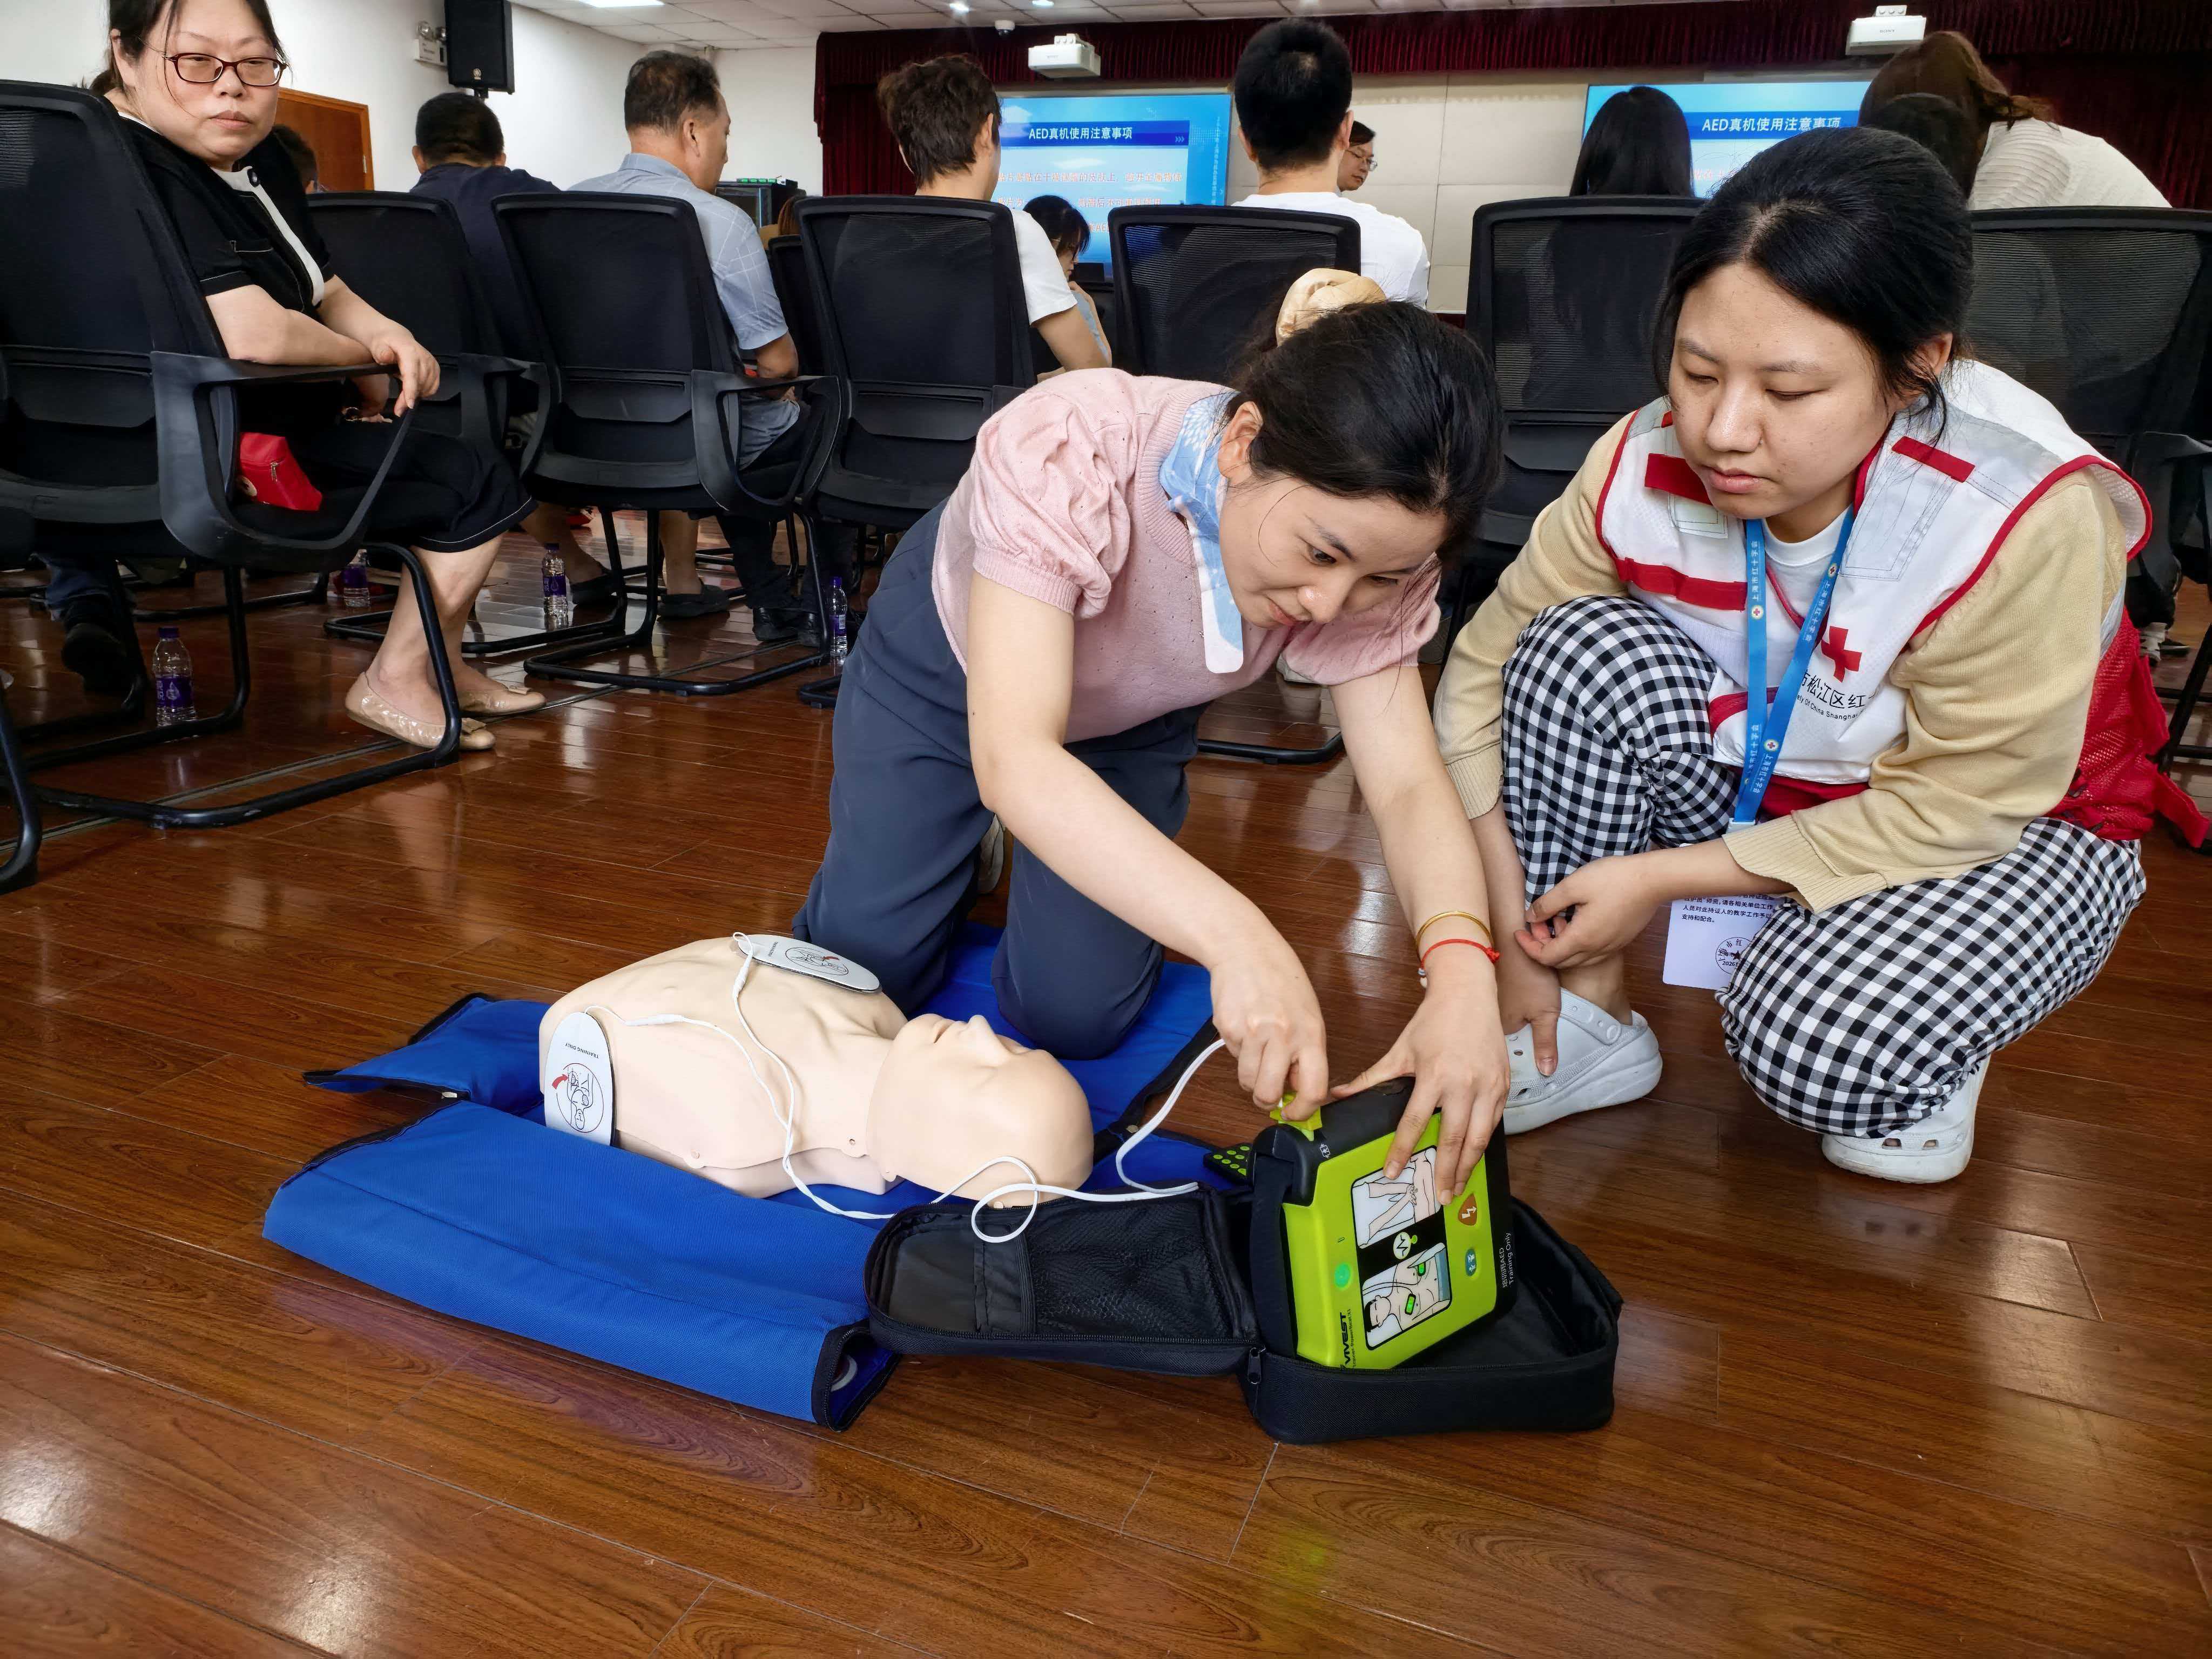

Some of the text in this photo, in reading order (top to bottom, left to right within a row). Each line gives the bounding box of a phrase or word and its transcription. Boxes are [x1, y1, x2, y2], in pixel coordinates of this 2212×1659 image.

[1702, 117, 1842, 132] AED真机使用注意事项
[1029, 127, 1133, 139] AED真机使用注意事项
[1802, 669, 1874, 709] 市松江区红
[1810, 703, 1824, 715] China
[564, 1042, 599, 1059] TRAINING ONLY
[1340, 1312, 1351, 1365] VIVEST
